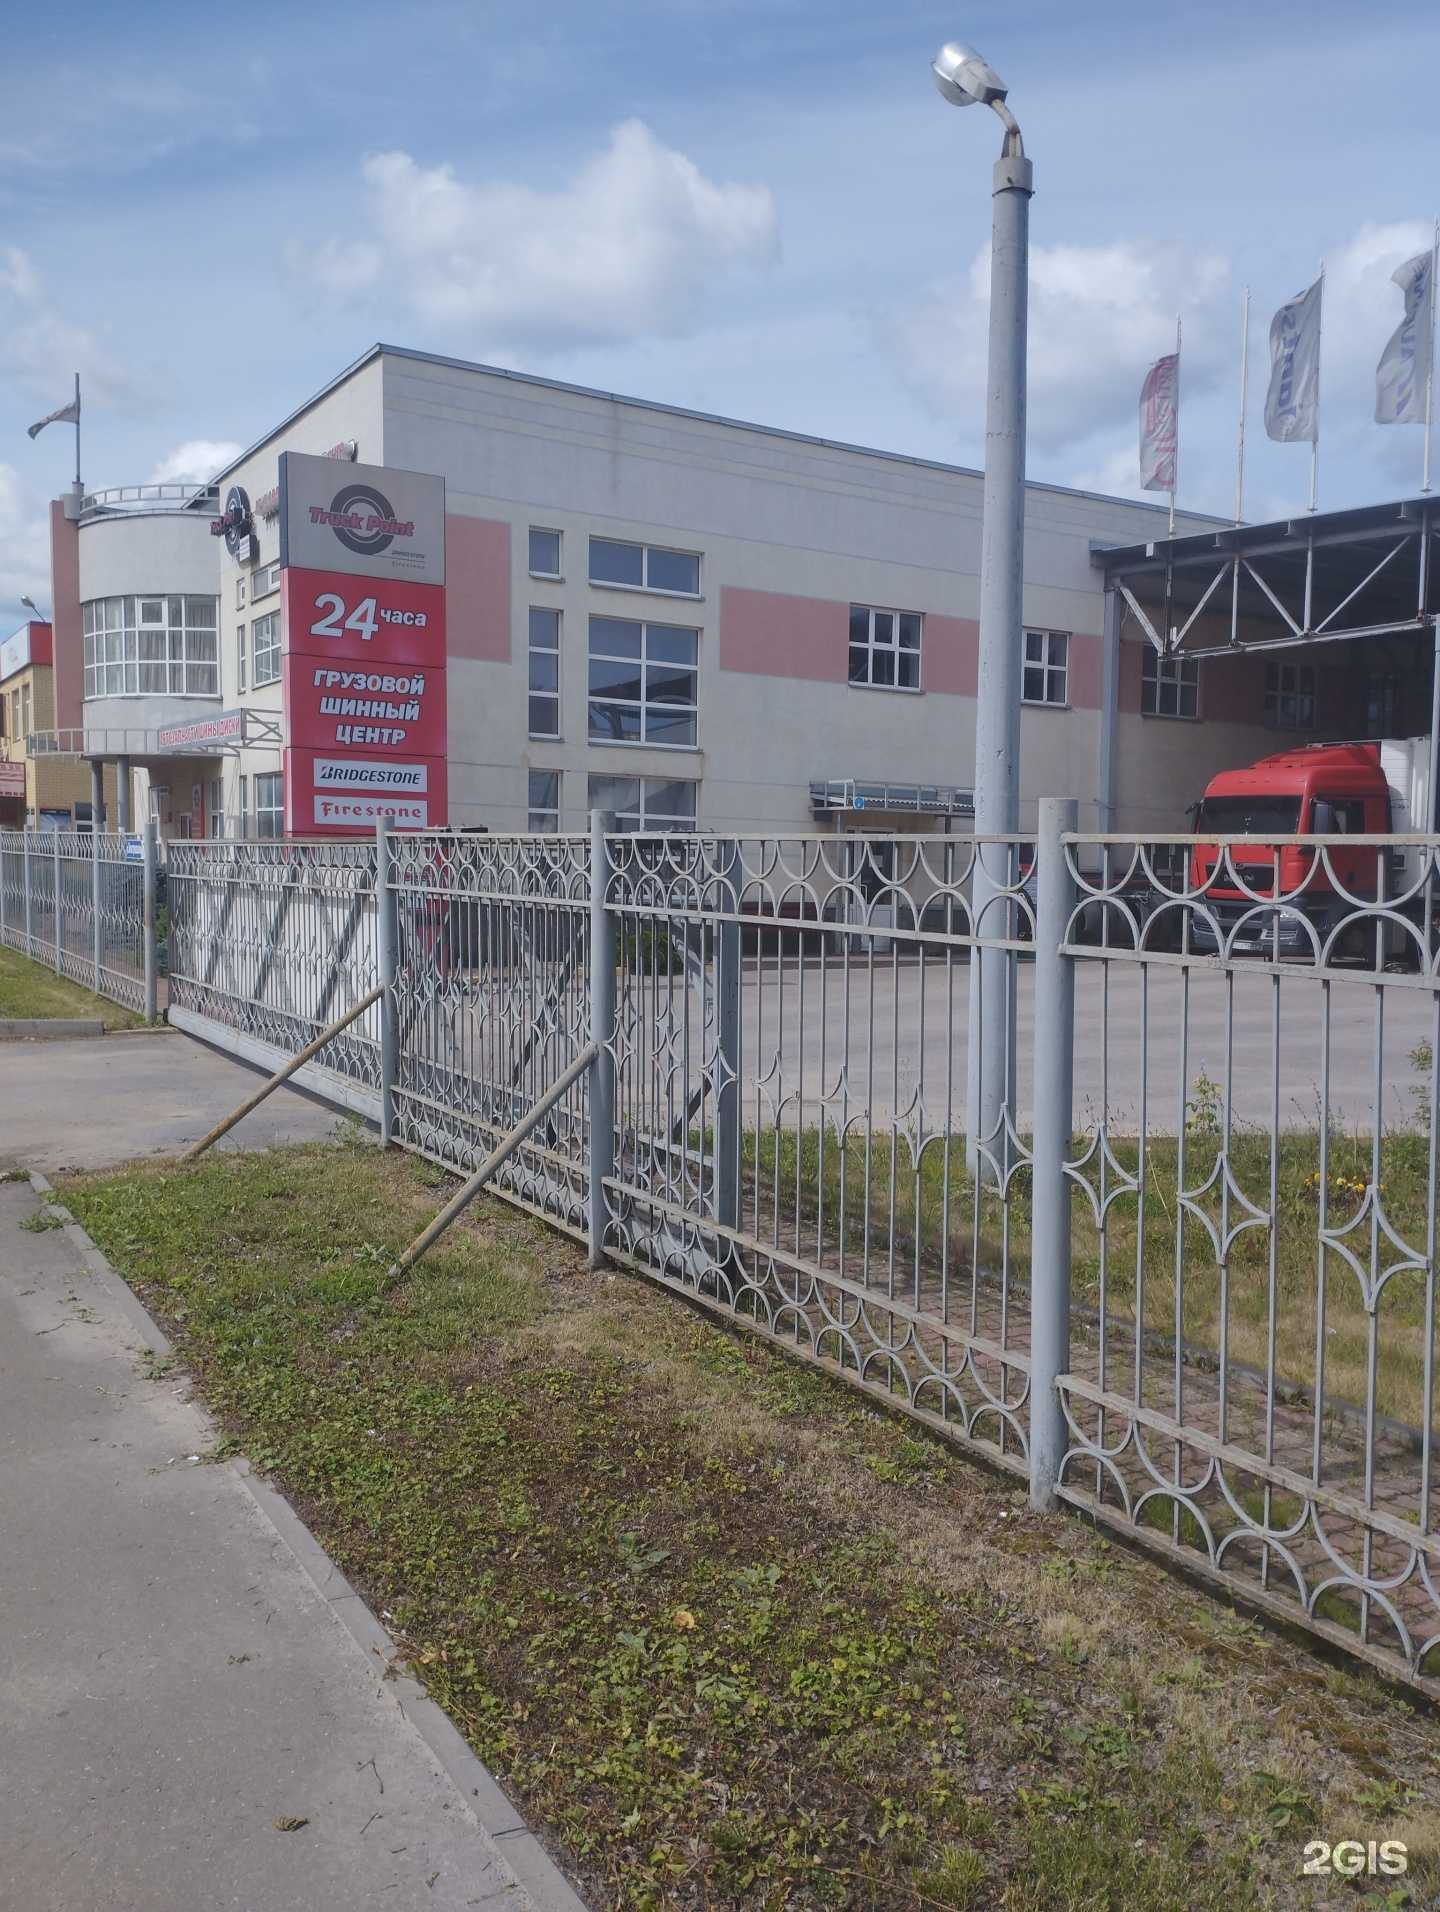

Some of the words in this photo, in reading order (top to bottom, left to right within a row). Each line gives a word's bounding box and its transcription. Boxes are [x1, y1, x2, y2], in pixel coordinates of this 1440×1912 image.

[309, 506, 363, 530] Truck
[366, 515, 415, 537] Point
[310, 593, 379, 641] 24
[380, 608, 427, 627] часа
[313, 669, 425, 696] ГРУЗОВОЙ
[319, 697, 420, 721] ШИННЫЙ
[335, 725, 406, 745] ЦЕНТР
[320, 801, 423, 818] Firestone
